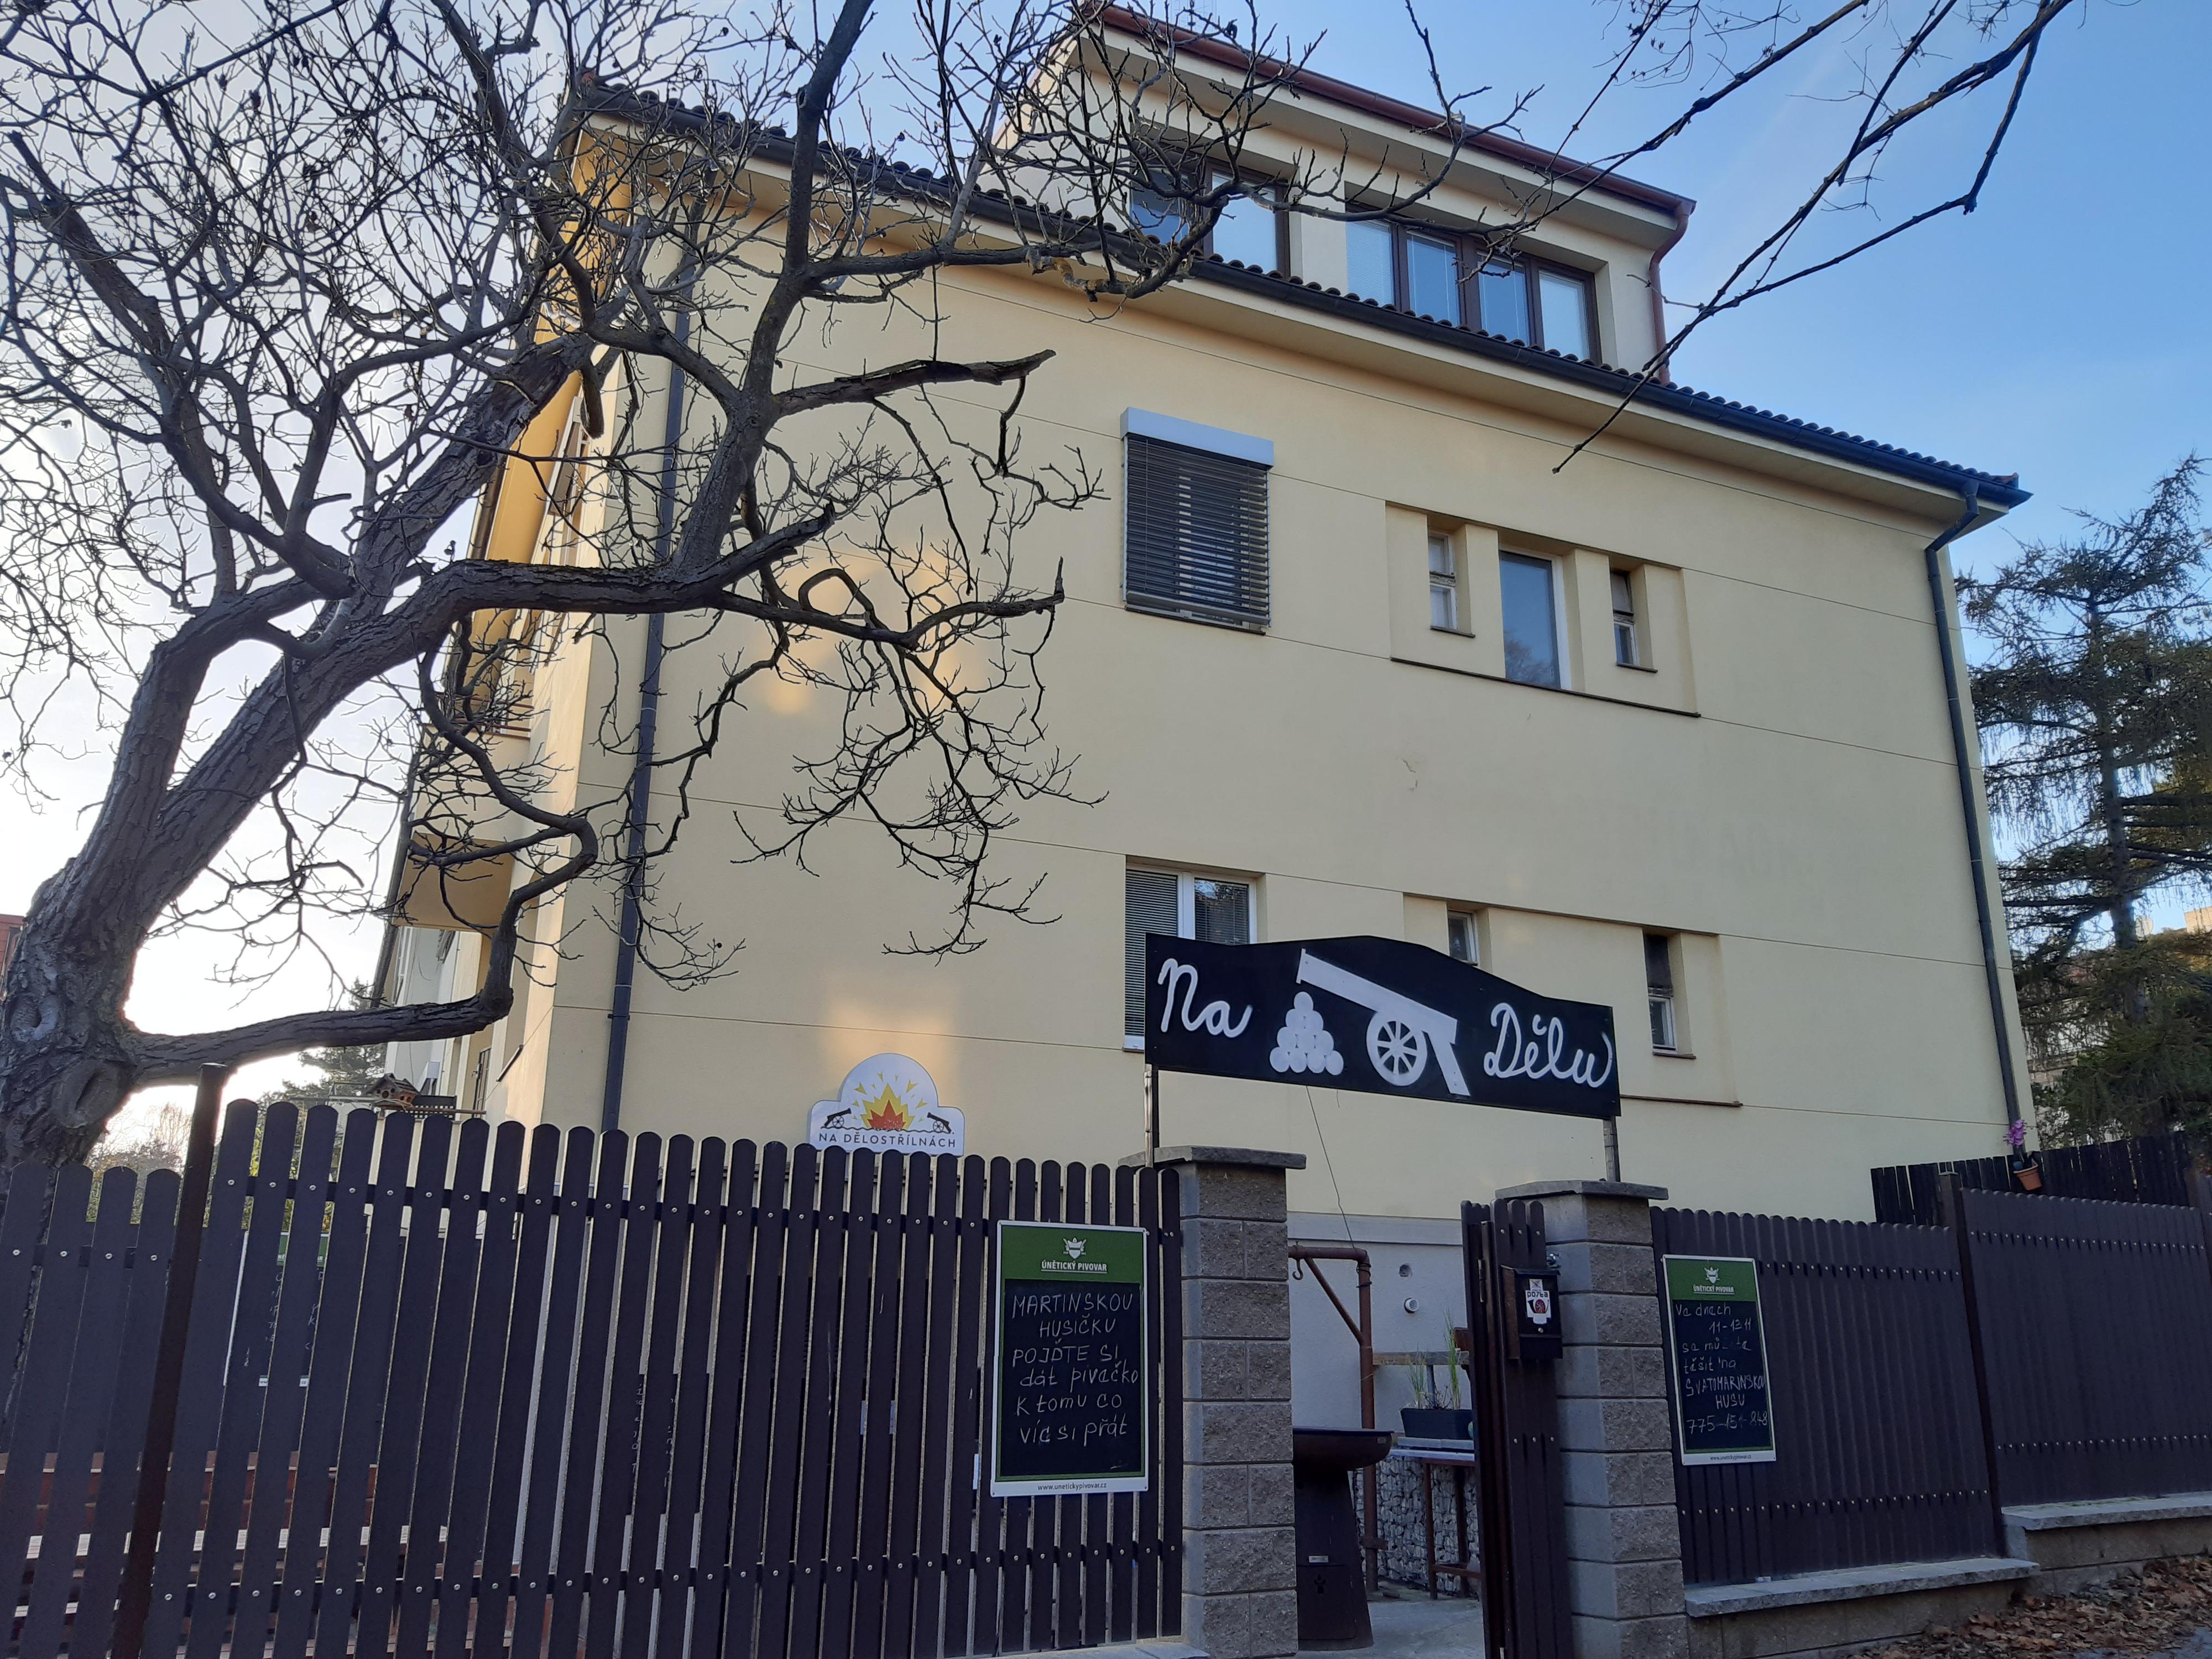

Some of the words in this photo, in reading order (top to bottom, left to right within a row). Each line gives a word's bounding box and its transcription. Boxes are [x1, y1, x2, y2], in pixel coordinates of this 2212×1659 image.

[1157, 957, 1254, 1039] Na
[1483, 1001, 1614, 1089] Dělu
[819, 1133, 837, 1142] NA
[844, 1131, 956, 1147] DĚLOSTŘÍLNÁCH
[1042, 1260, 1076, 1270] ÚNĚTICKÝ
[1078, 1262, 1107, 1271] PIVOVAR
[1040, 1313, 1116, 1338] HUSIČKU
[1020, 1366, 1057, 1386] dát
[1036, 1395, 1087, 1412] tomu
[1715, 1393, 1745, 1409] HUSU
[1037, 1482, 1107, 1491] www.unetickypivovar.cz
